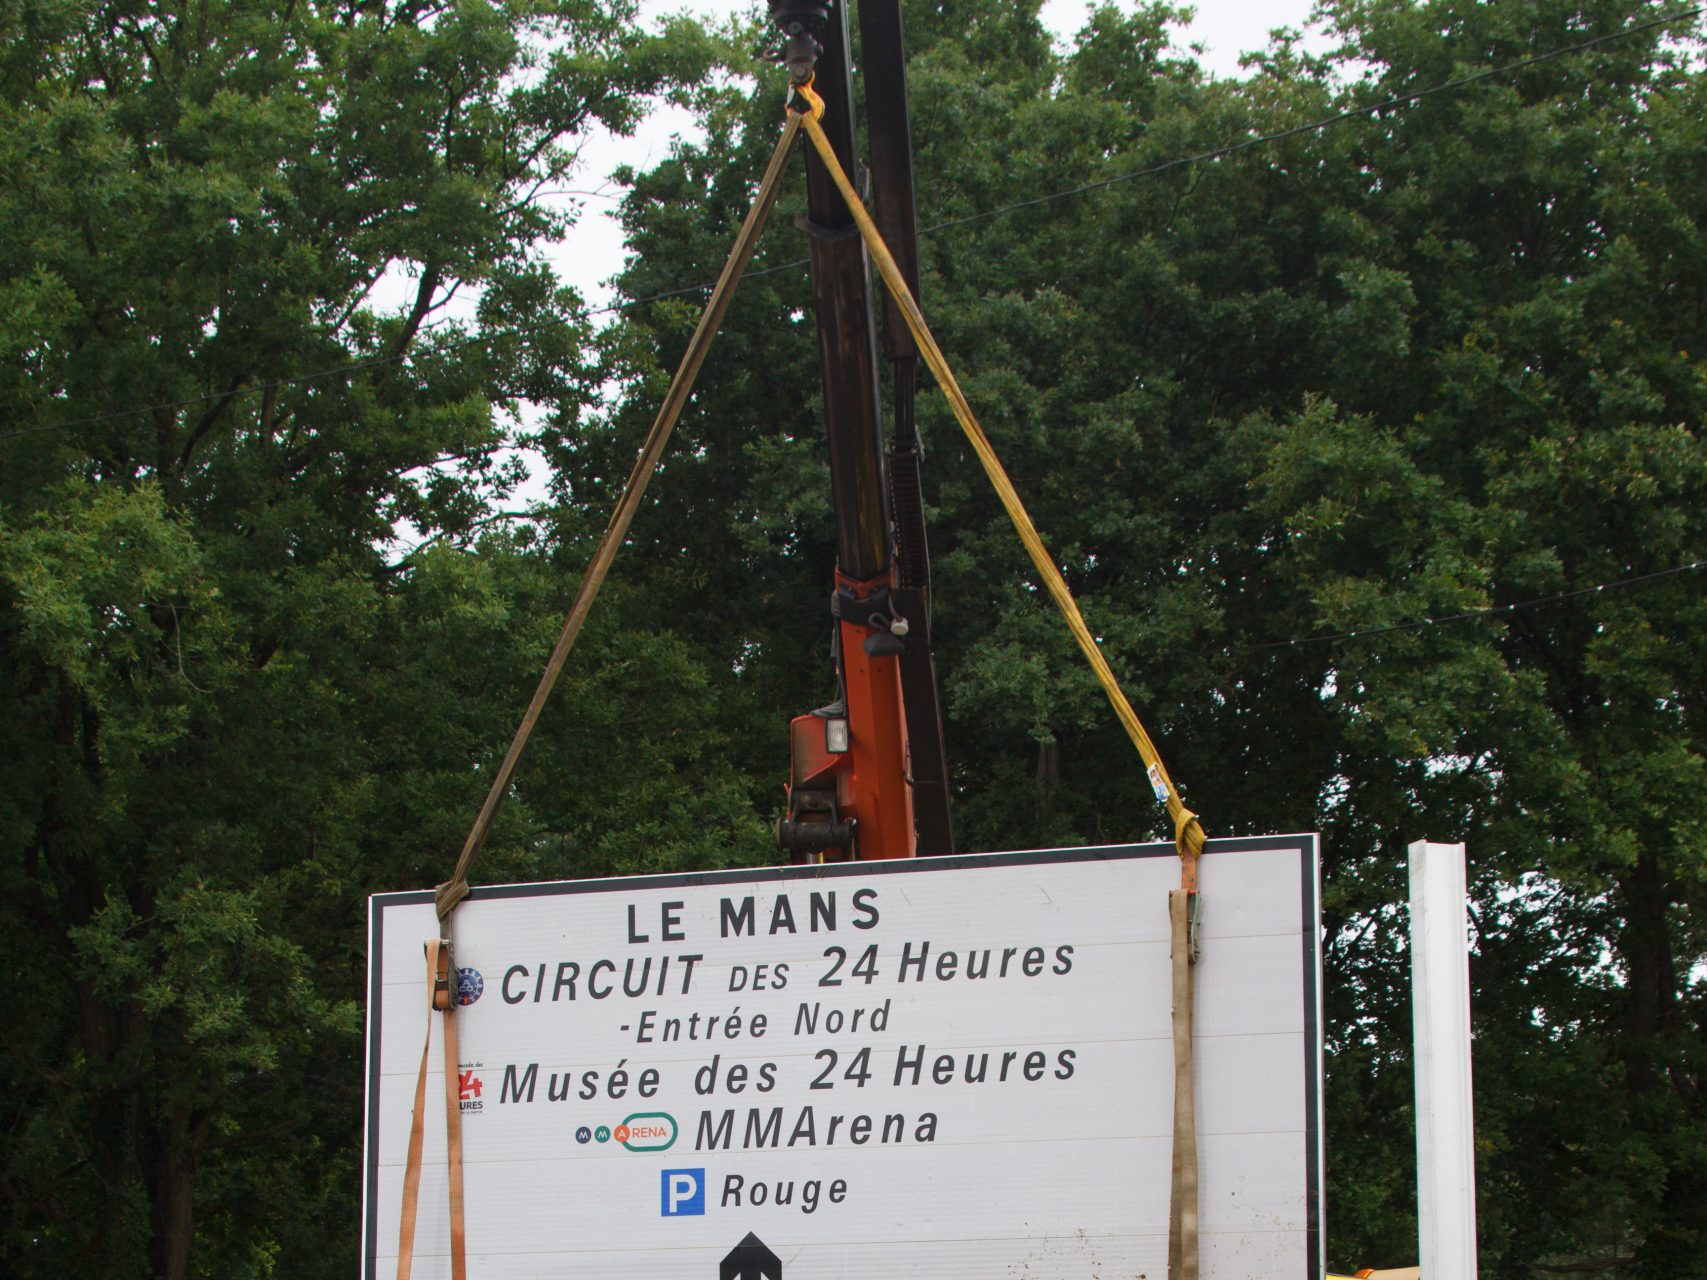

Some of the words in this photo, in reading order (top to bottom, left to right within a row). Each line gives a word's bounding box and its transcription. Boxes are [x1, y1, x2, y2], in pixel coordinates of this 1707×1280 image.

[627, 900, 686, 945] LE
[720, 888, 881, 938] MANS
[501, 953, 704, 1005] CIRCUIT
[728, 963, 790, 993] DES
[817, 943, 880, 988] 24
[897, 940, 1075, 983] Heures
[620, 1006, 768, 1044] -Entrée
[793, 998, 892, 1036] Nord
[499, 1058, 661, 1104] Musée
[694, 1054, 779, 1096] des
[809, 1046, 873, 1090] 24
[892, 1044, 1078, 1087] Heures
[459, 1100, 484, 1110] URES
[694, 1105, 939, 1152] MMArena
[669, 1174, 697, 1214] P
[720, 1174, 849, 1215] Rouge
